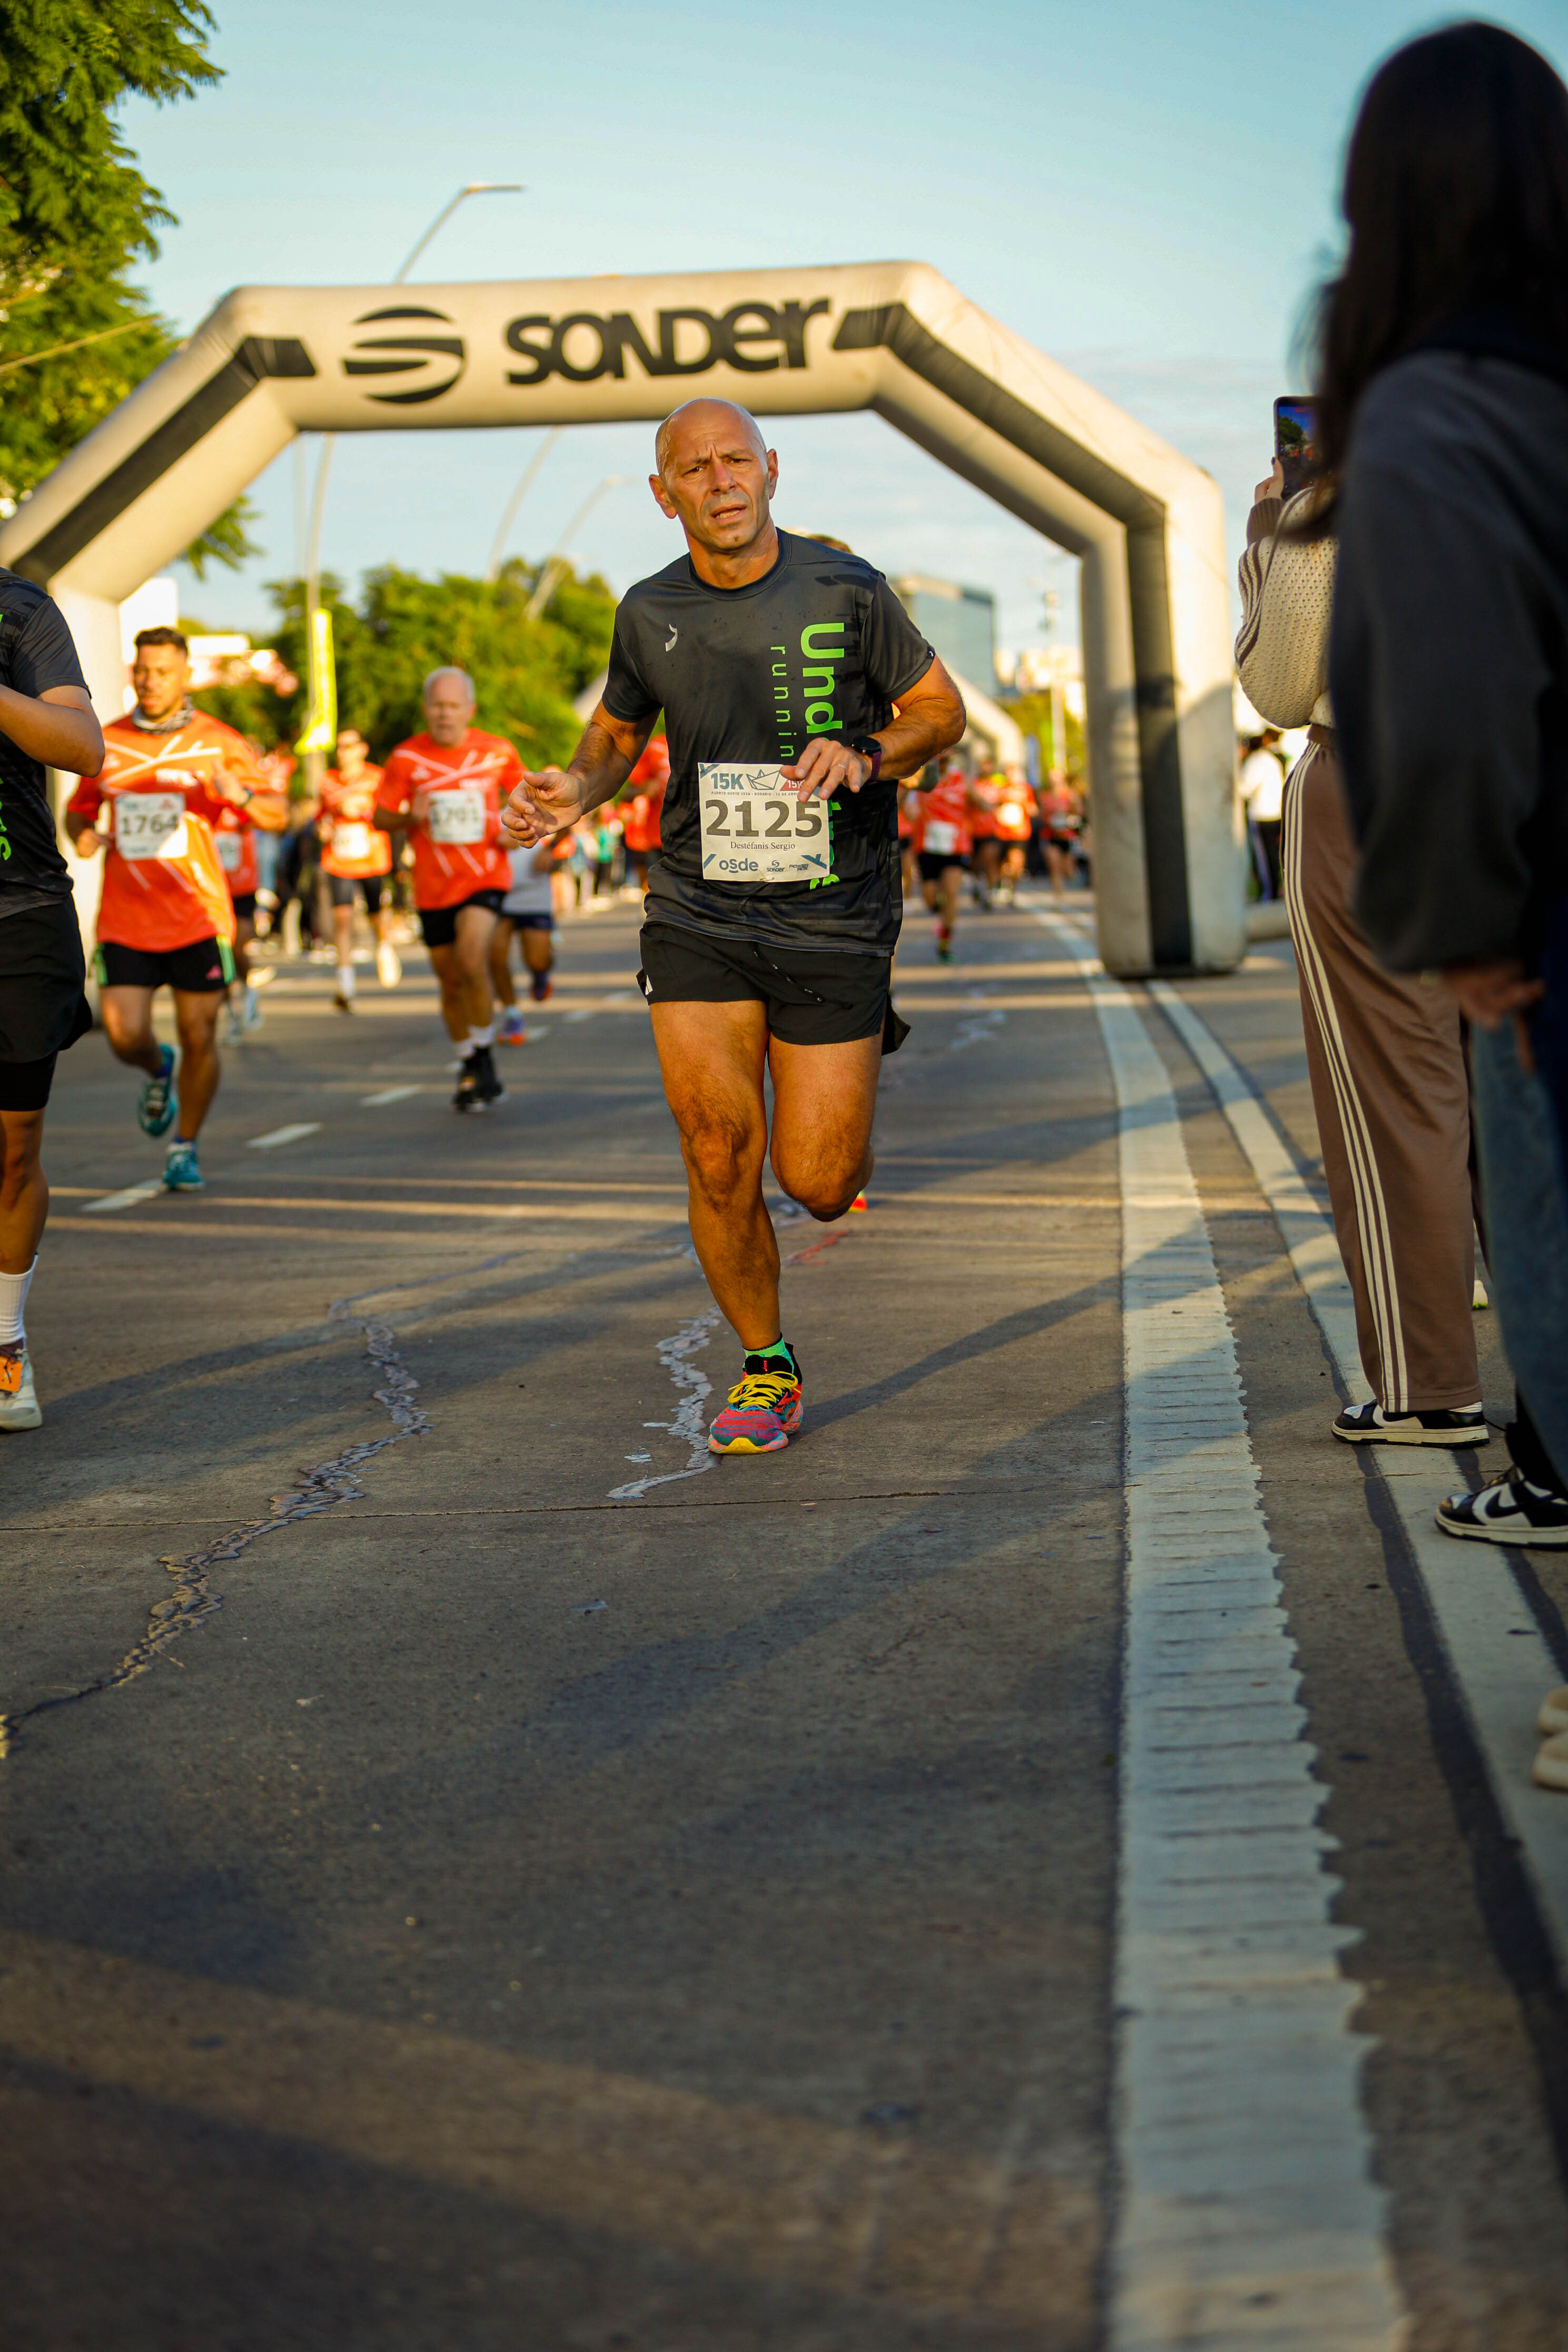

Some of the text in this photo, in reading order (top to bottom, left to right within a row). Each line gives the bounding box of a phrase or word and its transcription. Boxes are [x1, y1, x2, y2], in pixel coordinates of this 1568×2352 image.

[800, 622, 845, 741] Und
[770, 646, 797, 757] runnin
[711, 772, 744, 790] 15K
[122, 813, 179, 835] 1764
[705, 799, 822, 837] 2125
[771, 842, 795, 851] Sergio
[719, 857, 759, 873] osde
